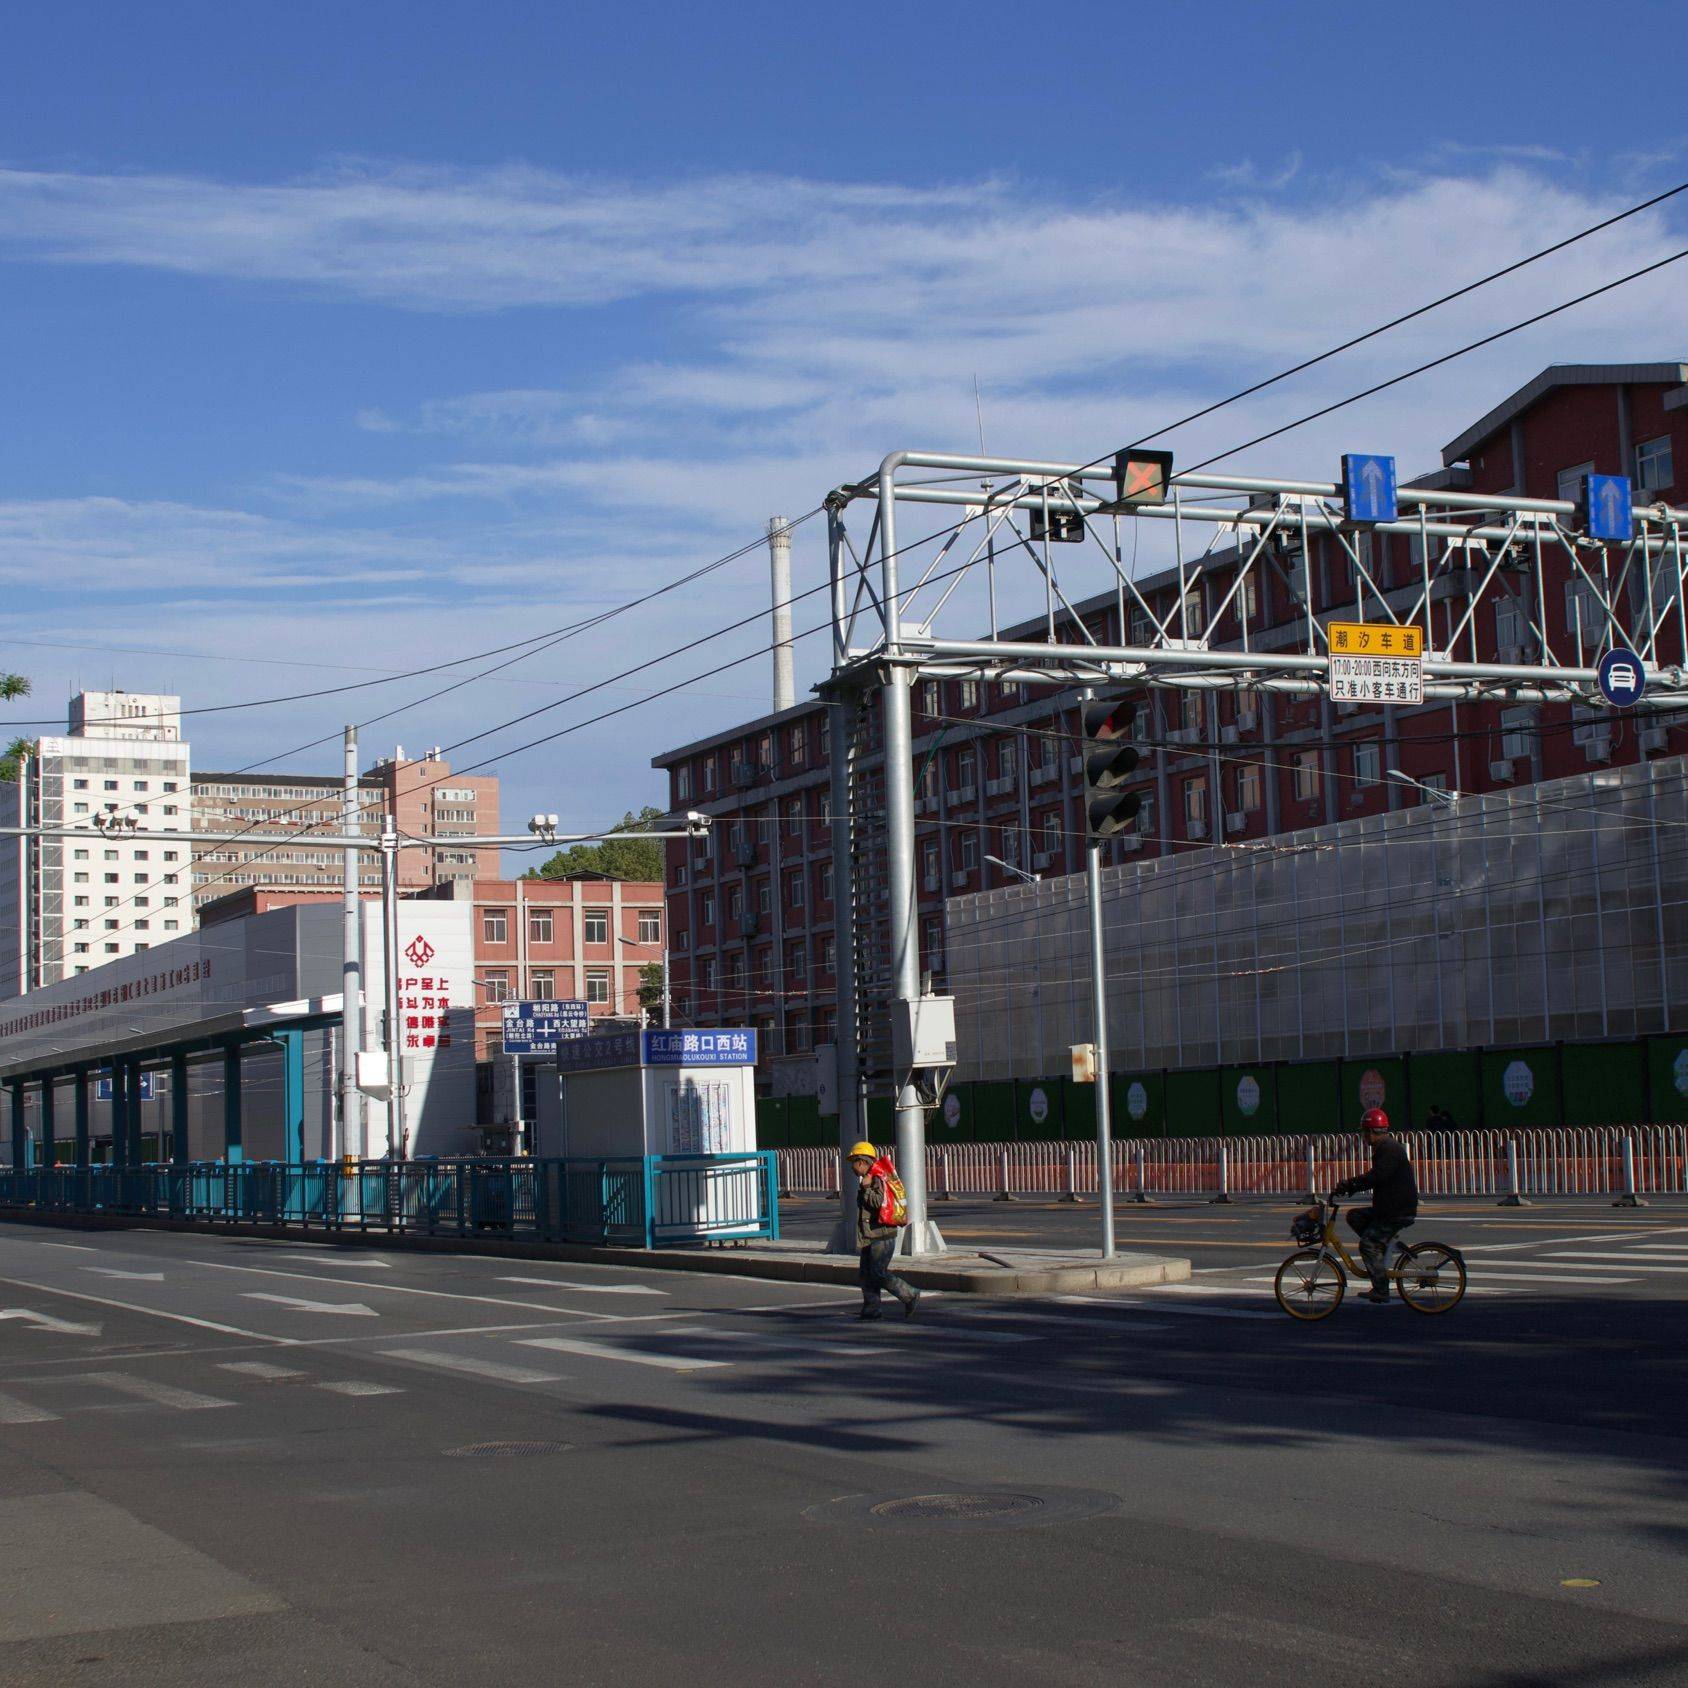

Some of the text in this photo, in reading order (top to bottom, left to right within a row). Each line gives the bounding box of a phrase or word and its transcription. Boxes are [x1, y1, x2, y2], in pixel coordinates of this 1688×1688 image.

[1335, 630, 1415, 651] 潮汐车道
[1335, 680, 1419, 700] 只准小客车通行
[506, 1019, 534, 1028] 金台路
[553, 1019, 587, 1028] 西大望路
[652, 1033, 748, 1051] 红庙路口西站
[652, 1053, 716, 1061] HONGMIAOLUKOUXI
